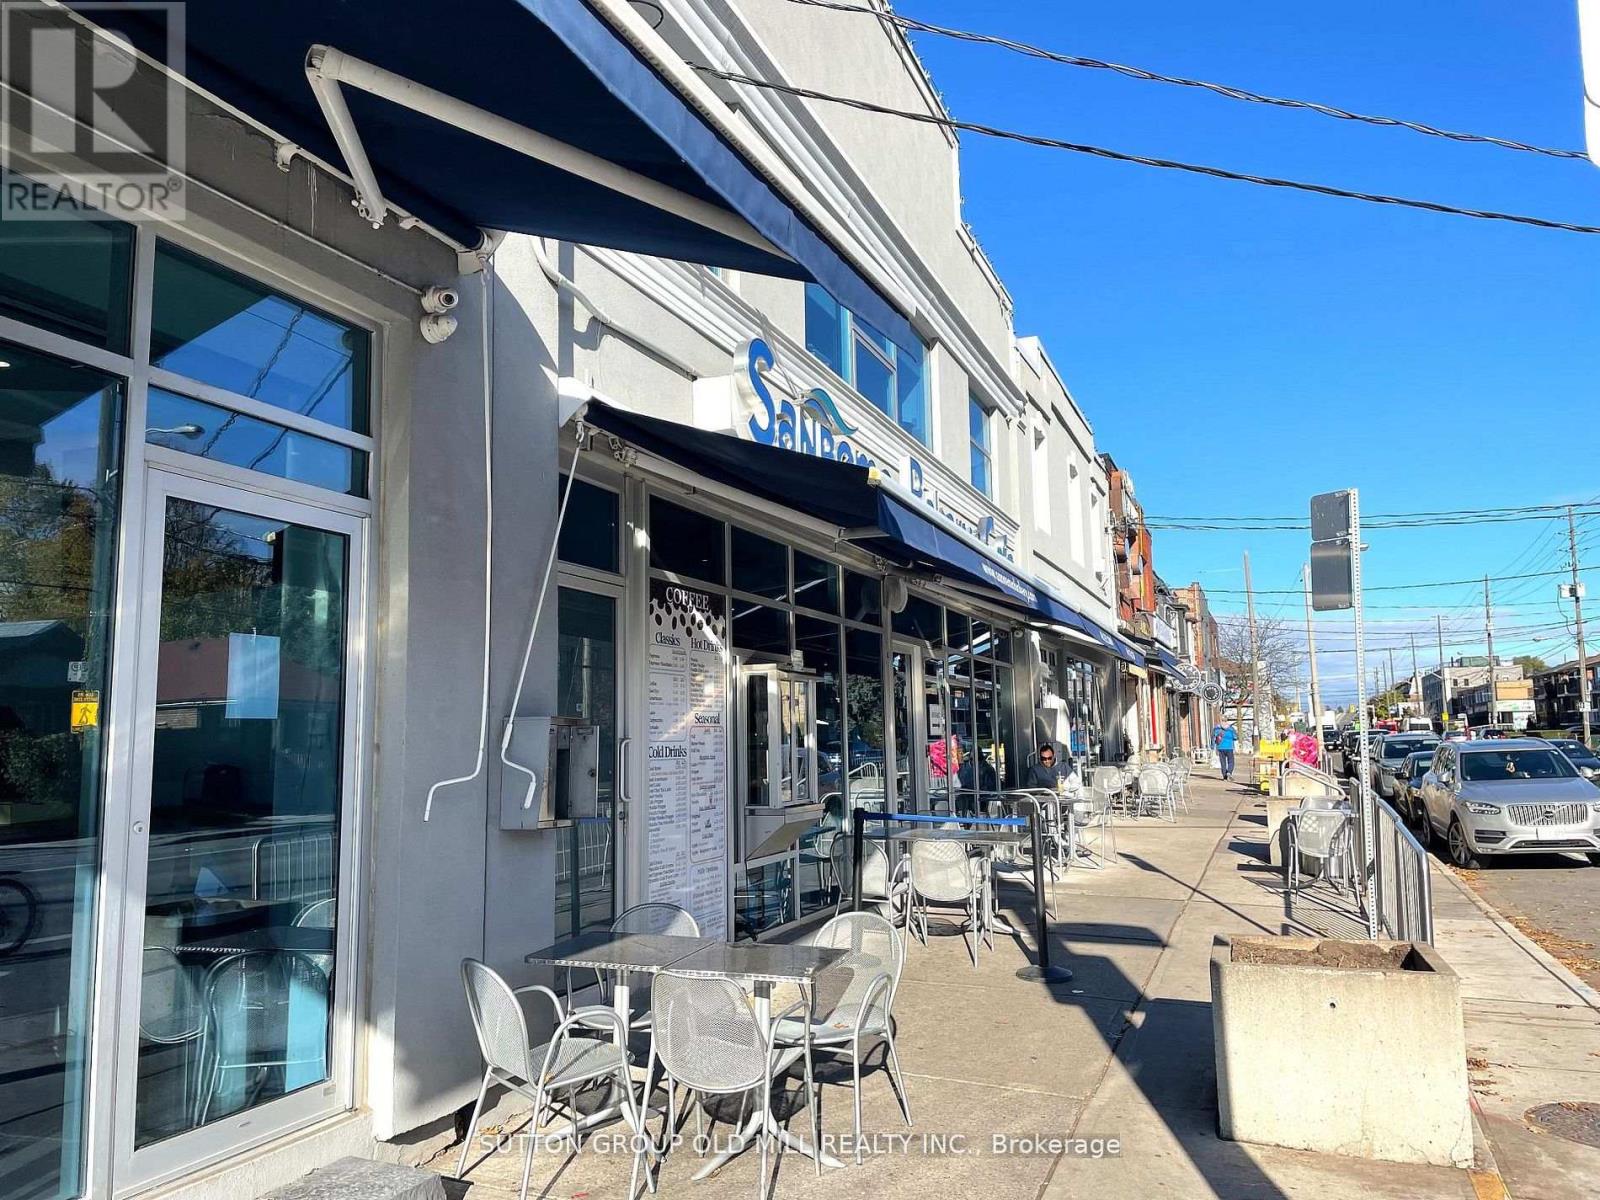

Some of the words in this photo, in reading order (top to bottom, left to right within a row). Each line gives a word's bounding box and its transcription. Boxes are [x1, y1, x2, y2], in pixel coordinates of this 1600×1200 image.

[666, 586, 709, 611] COFFEE
[655, 632, 681, 647] Classics
[691, 637, 703, 650] Hot
[694, 712, 720, 725] Seasonal
[649, 745, 665, 759] Cold
[665, 744, 687, 758] Drinks
